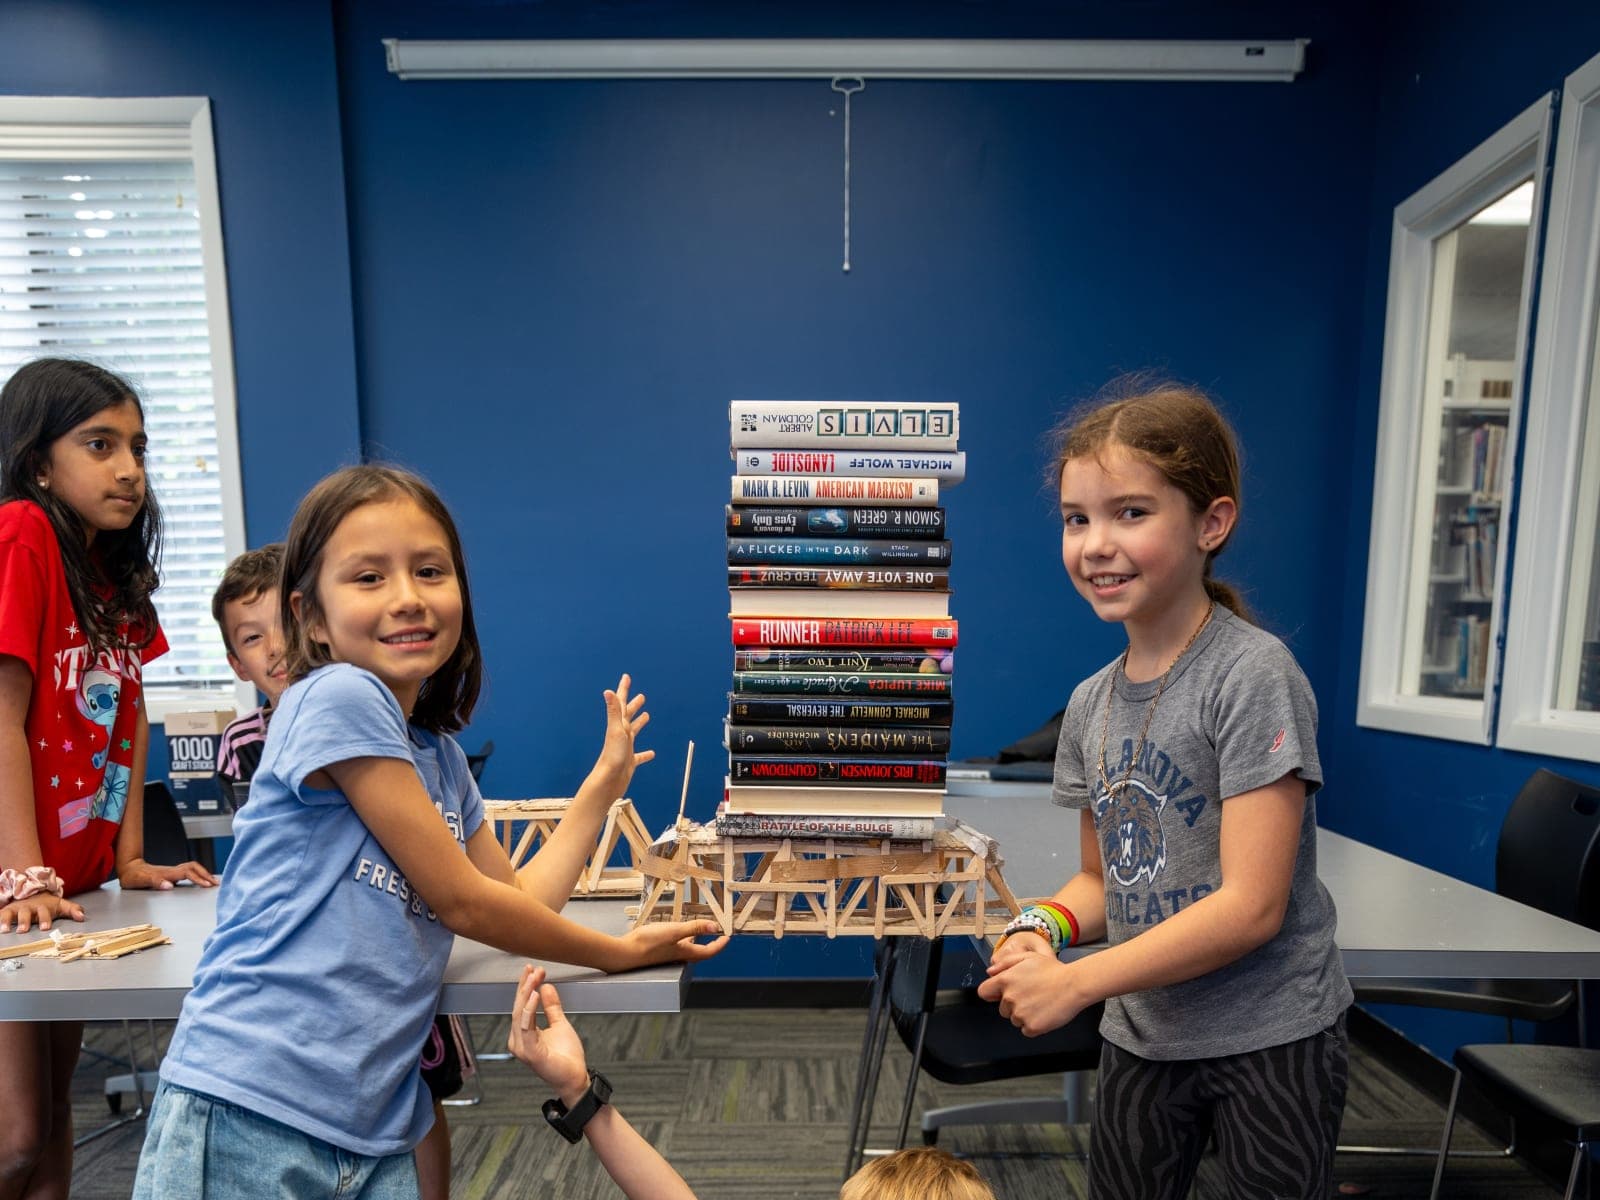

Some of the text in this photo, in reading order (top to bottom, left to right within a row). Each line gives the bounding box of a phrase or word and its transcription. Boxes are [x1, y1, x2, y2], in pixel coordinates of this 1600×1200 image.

[762, 414, 815, 425] GOLDMAN
[822, 414, 945, 435] ELVIS
[778, 423, 813, 433] ALBERT
[771, 453, 836, 473] LANDSLIDE
[849, 458, 953, 470] MICHAEL WOLFF
[742, 479, 810, 498] MARK R. LEVIN
[815, 480, 865, 499] AMERICAN
[867, 481, 913, 500] MARXISM
[751, 513, 772, 526] Only
[775, 515, 798, 528] Eyes
[853, 509, 941, 526] SIMON R. GREEN
[737, 546, 745, 554] A
[749, 545, 802, 555] FLICKER
[834, 545, 870, 556] DARK
[760, 570, 818, 583] TED CRUZ
[823, 570, 935, 584] ONE VOTE AWAY
[760, 620, 916, 645] RUNNER PATRICK LEE
[802, 675, 860, 692] Miracle
[868, 679, 946, 691] MIKE LUPICA
[786, 704, 846, 718] THE REVERSAL
[849, 706, 930, 719] MICHAEL CONNELLY
[767, 731, 820, 739] MICHAELIDES
[828, 732, 933, 747] THE MAIDENS
[170, 737, 214, 761] 1000
[171, 760, 215, 771] CRAFT STICKS
[752, 762, 817, 778] COUNTDOWN
[841, 764, 893, 778] JOHANSEN
[893, 765, 914, 778] IRIS
[760, 821, 807, 832] BATTLE
[809, 822, 825, 832] OF
[828, 822, 853, 833] THE
[855, 823, 894, 833] BULGE
